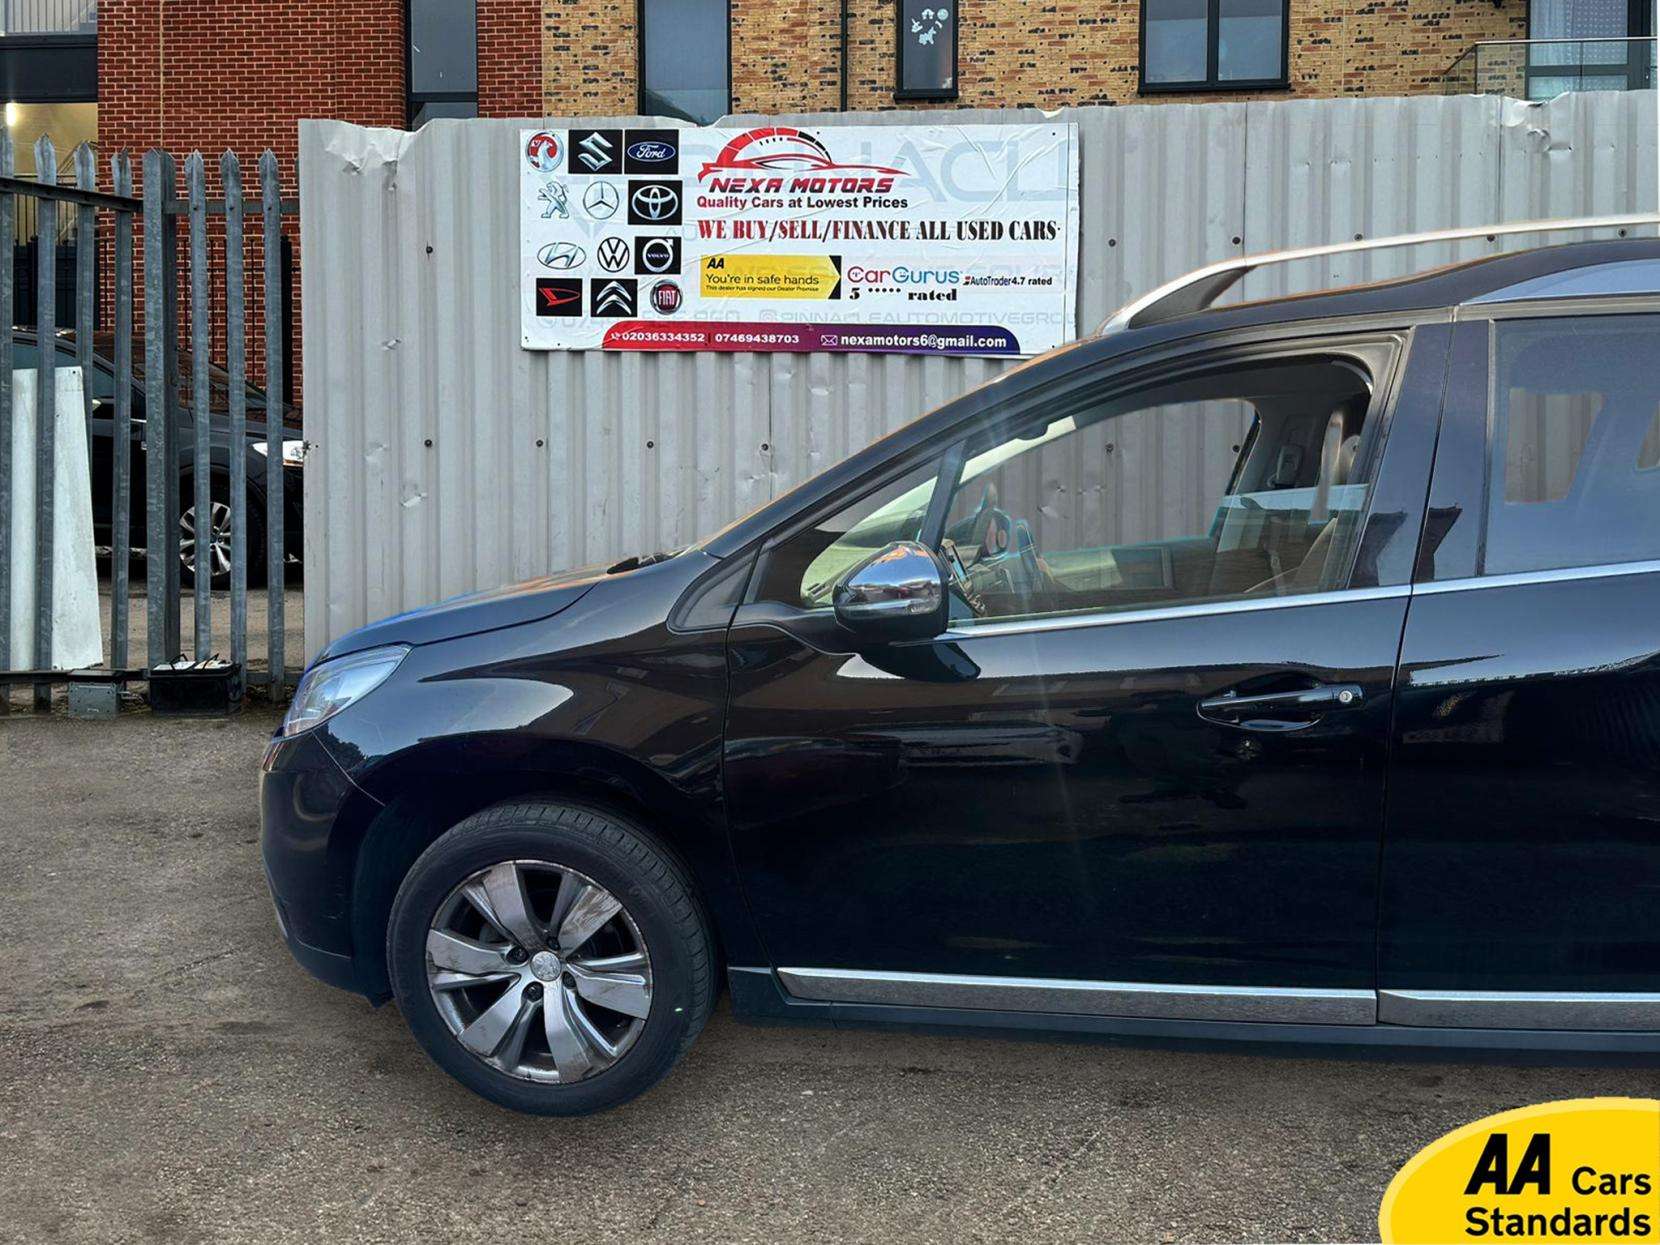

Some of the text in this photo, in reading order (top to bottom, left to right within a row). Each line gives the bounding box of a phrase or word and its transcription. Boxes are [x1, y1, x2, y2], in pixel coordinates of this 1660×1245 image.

[709, 177, 894, 193] NEXA MOTORS
[697, 196, 908, 210] Quality Cars at Lowest Prices
[698, 219, 1057, 242] WE BUY/SELL/FINANCE ALL USED CARS
[707, 257, 725, 269] AA
[706, 274, 819, 285] You're in safe hands
[847, 266, 960, 284] CarGurus
[1027, 277, 1052, 286] rated
[658, 291, 676, 305] FIAT
[850, 288, 957, 301] 5 rated
[621, 331, 1007, 349] 02036334352 07469438703 nexamotors6@gmail.com
